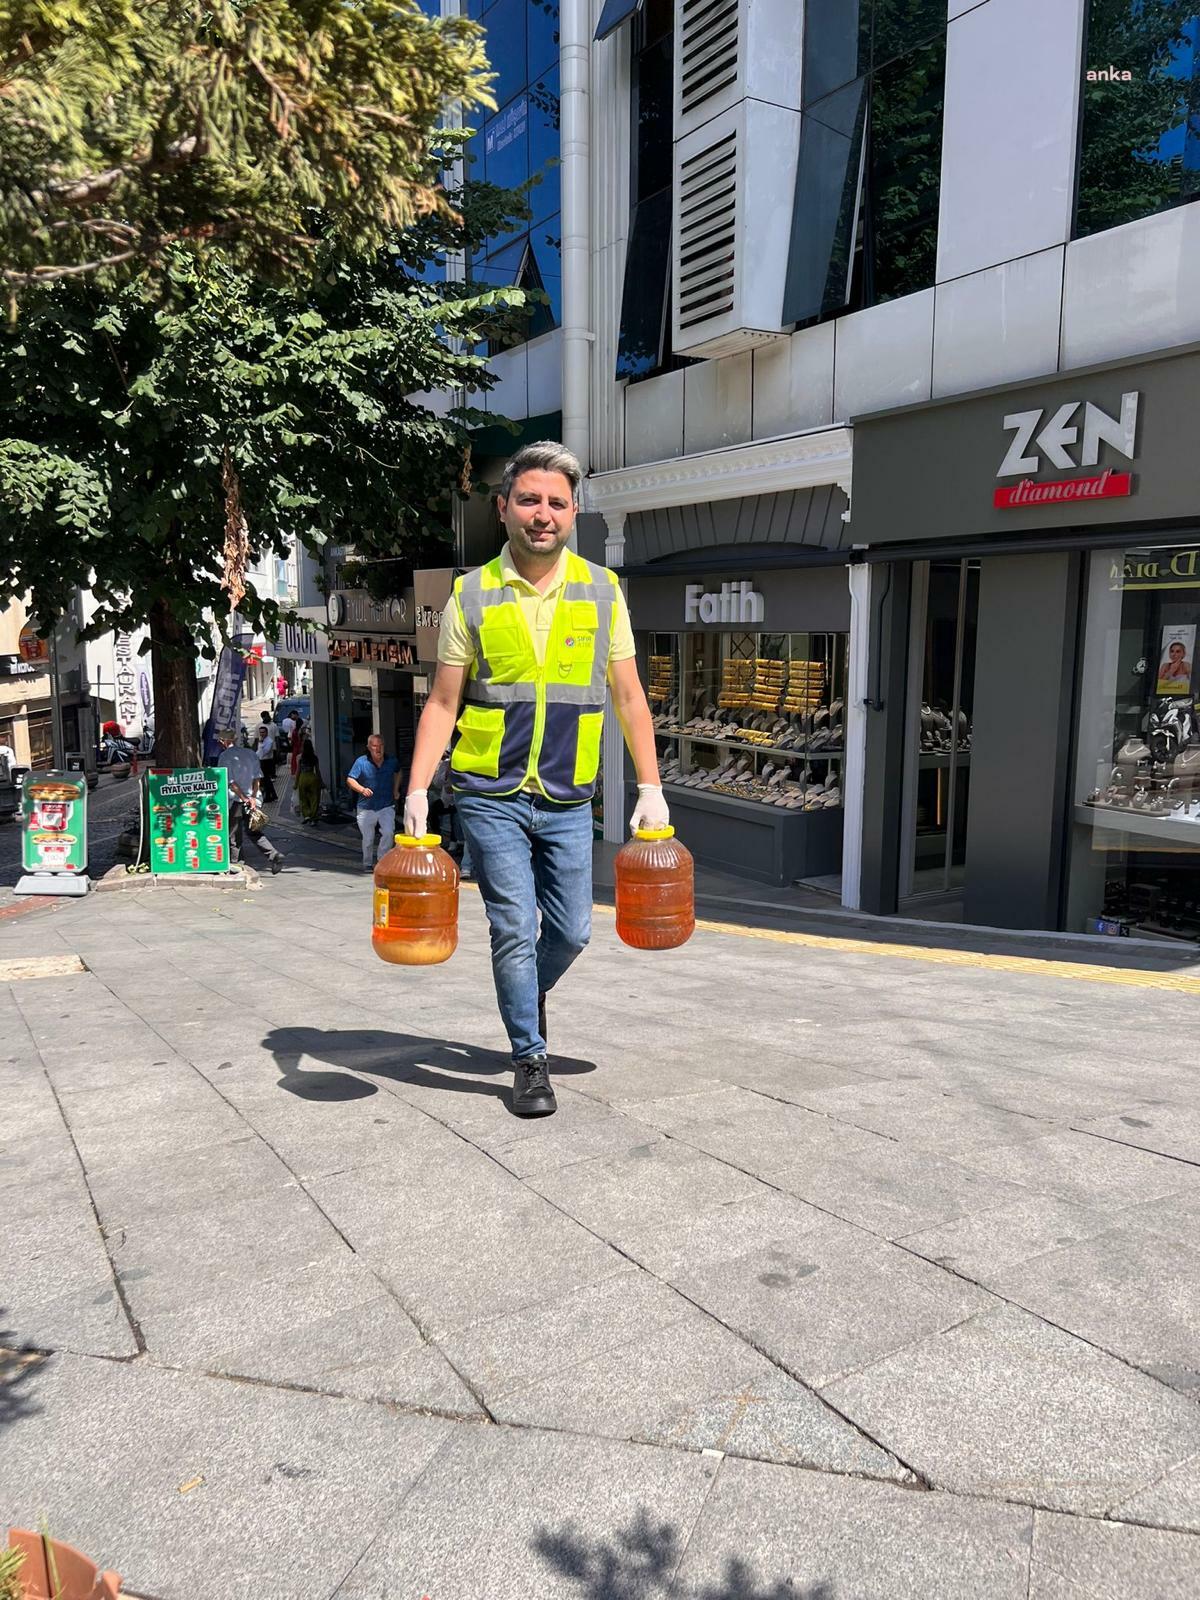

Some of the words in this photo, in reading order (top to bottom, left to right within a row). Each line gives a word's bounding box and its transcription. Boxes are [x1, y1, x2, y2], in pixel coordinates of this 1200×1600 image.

[996, 391, 1139, 478] ZEN
[1009, 468, 1113, 504] diamond
[416, 606, 444, 628] Ekre
[684, 581, 765, 624] Fatih
[179, 771, 206, 784] LEZZET
